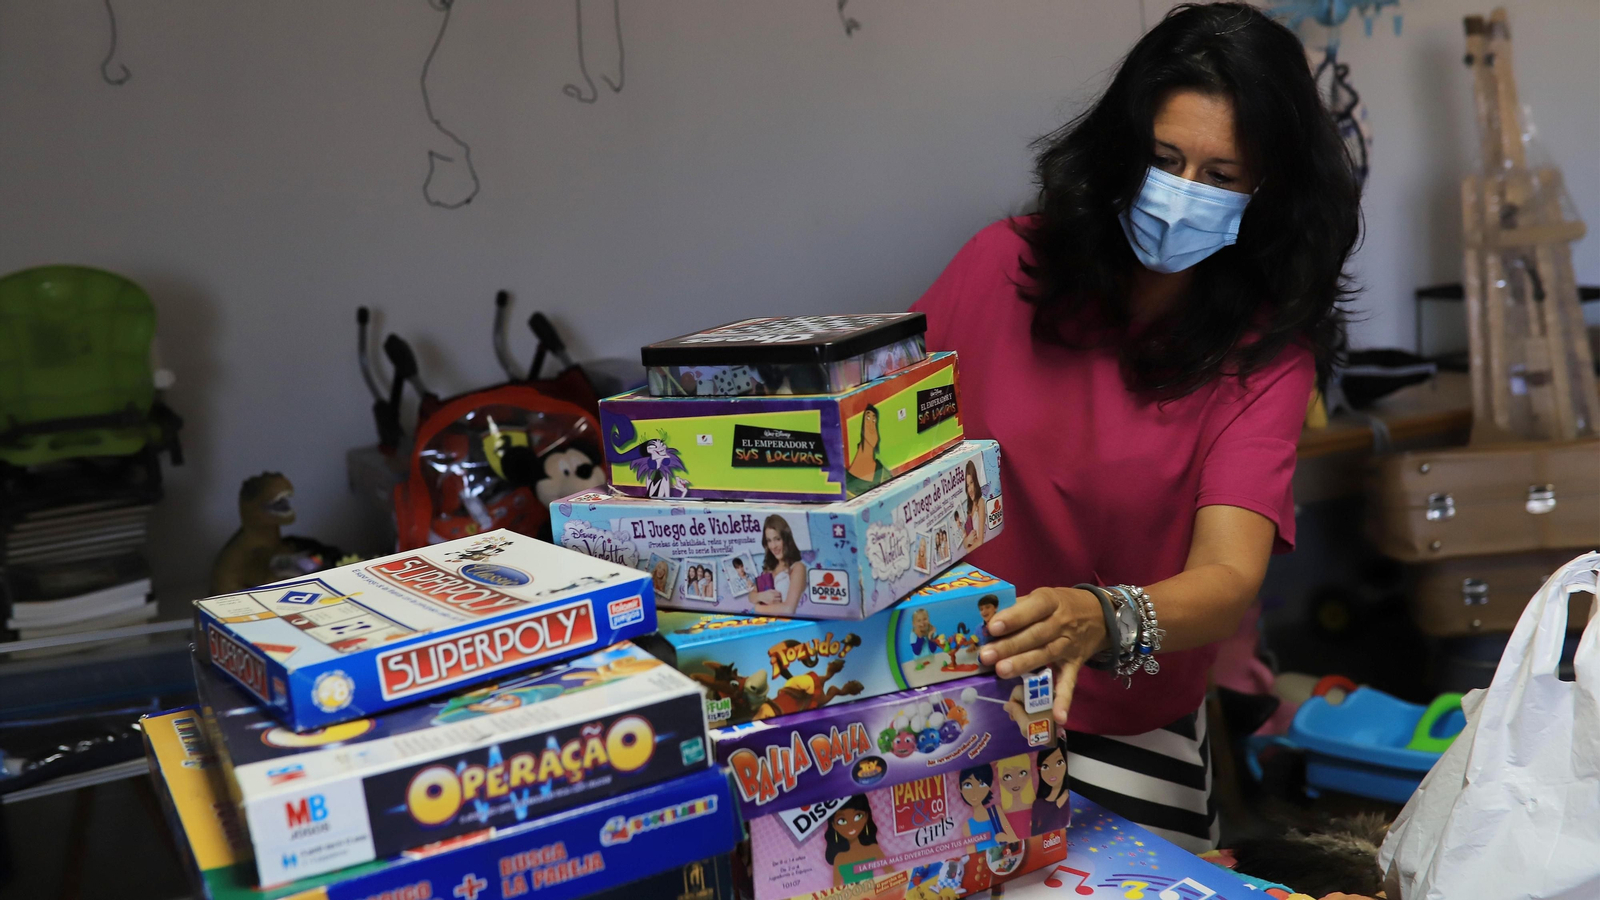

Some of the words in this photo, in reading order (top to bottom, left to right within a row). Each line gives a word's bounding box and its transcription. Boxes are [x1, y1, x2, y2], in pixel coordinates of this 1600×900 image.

[742, 439, 754, 448] EL
[754, 440, 808, 450] EMPERADOR
[808, 441, 815, 450] Y
[903, 502, 912, 523] El
[912, 494, 932, 517] Juego
[933, 484, 942, 502] de
[941, 466, 965, 495] Violetta
[569, 527, 597, 542] Disney
[631, 519, 646, 539] El
[649, 522, 686, 542] Juego
[690, 517, 707, 536] de
[708, 514, 762, 535] Violetta
[672, 540, 679, 548] de
[380, 559, 521, 611] SUPERPOLY
[812, 586, 847, 597] BORRAS
[388, 608, 578, 692] SUPERPOLY
[707, 698, 731, 712] FUN
[406, 714, 656, 827] OPERAÇÃO
[728, 730, 813, 806] BALLA
[808, 722, 873, 776] BALLA
[894, 774, 946, 806] PARTY
[285, 794, 329, 829] MB
[911, 799, 932, 827] &
[931, 798, 944, 814] CO
[915, 816, 955, 848] Girls
[500, 841, 568, 877] BUSCA
[859, 863, 868, 872] LA
[868, 860, 888, 870] FIESTA
[904, 848, 934, 860] DIVERTIDA
[935, 844, 951, 853] CON
[951, 841, 963, 850] TUS
[963, 833, 987, 846] AMIGAS
[502, 872, 529, 898] LA
[532, 850, 605, 890] PAREJA
